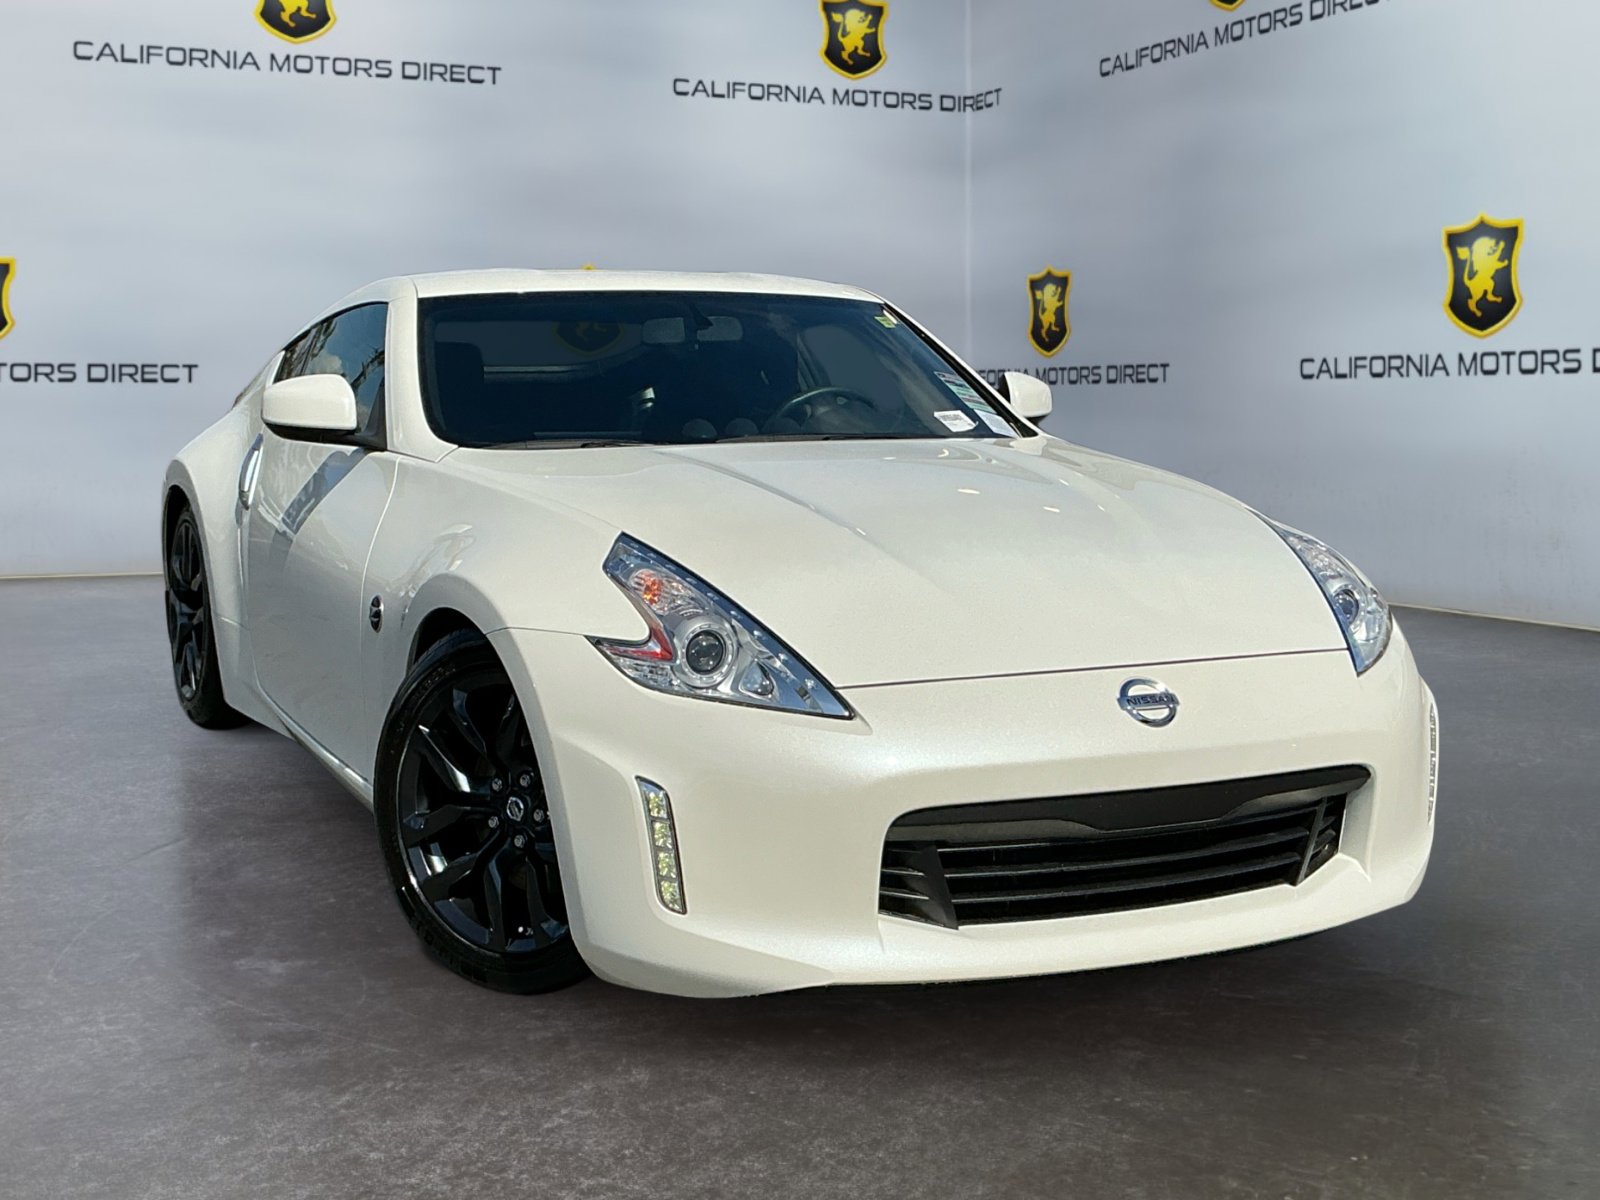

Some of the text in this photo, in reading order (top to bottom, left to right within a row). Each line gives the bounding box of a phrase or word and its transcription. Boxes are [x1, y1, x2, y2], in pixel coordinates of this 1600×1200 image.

[1100, 0, 1380, 78] CALIFORNIA MOTORS DIR
[73, 41, 502, 85] CALIFORNIA MOTORS DIRECT
[673, 78, 1002, 113] CALIFORNIA MOTORS DIRECT
[87, 363, 199, 383] DIRECT
[1106, 363, 1170, 384] DIRECT
[1300, 353, 1450, 380] CALIFORNIA
[1458, 349, 1582, 376] MOTORS
[1126, 693, 1175, 706] NISSAN
